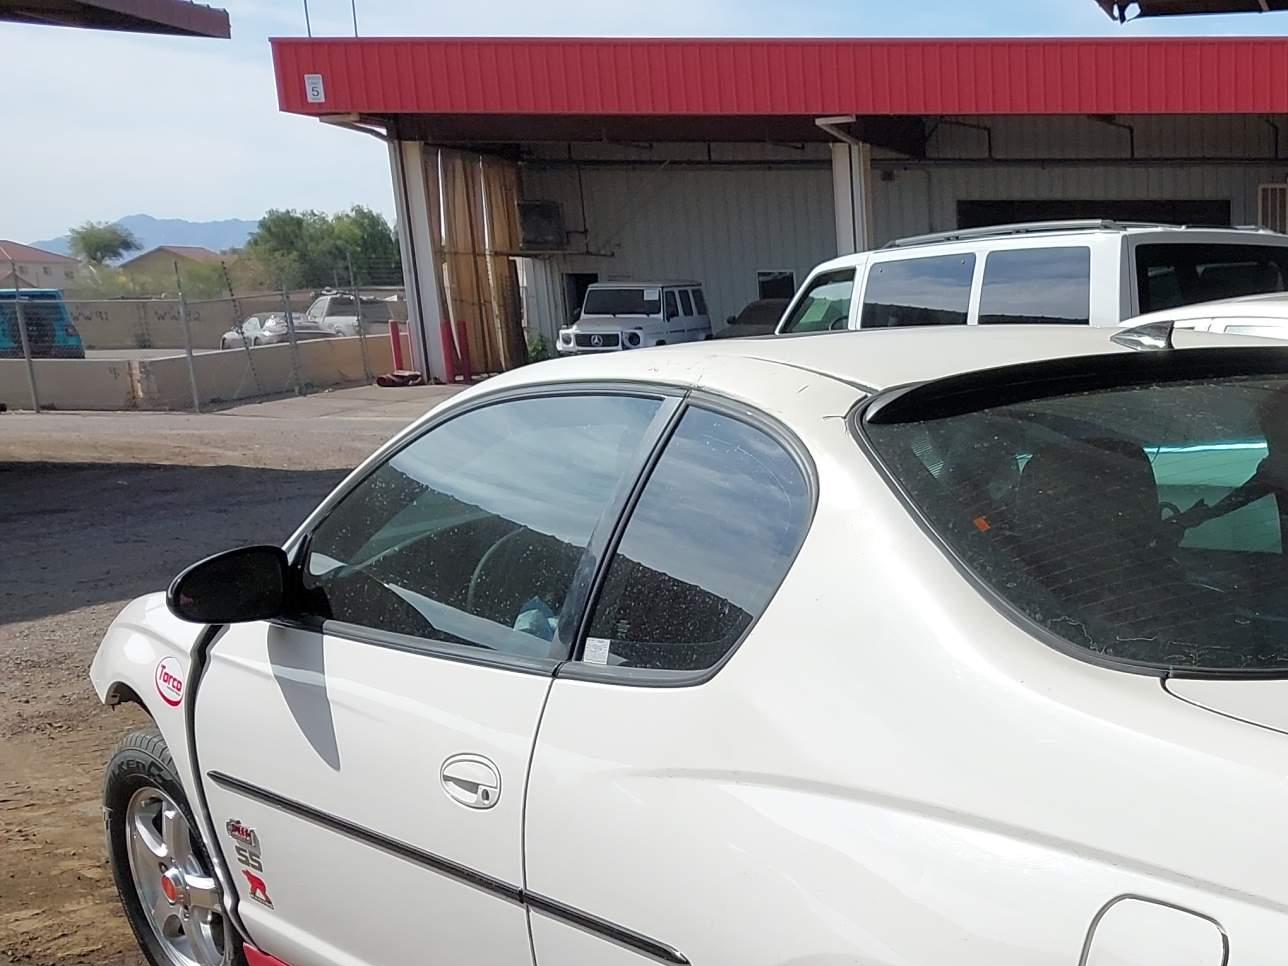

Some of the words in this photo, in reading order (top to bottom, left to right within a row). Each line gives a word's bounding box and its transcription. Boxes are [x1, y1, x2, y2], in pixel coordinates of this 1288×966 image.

[311, 86, 320, 97] 5
[160, 664, 183, 692] Torco
[234, 844, 264, 873] SS
